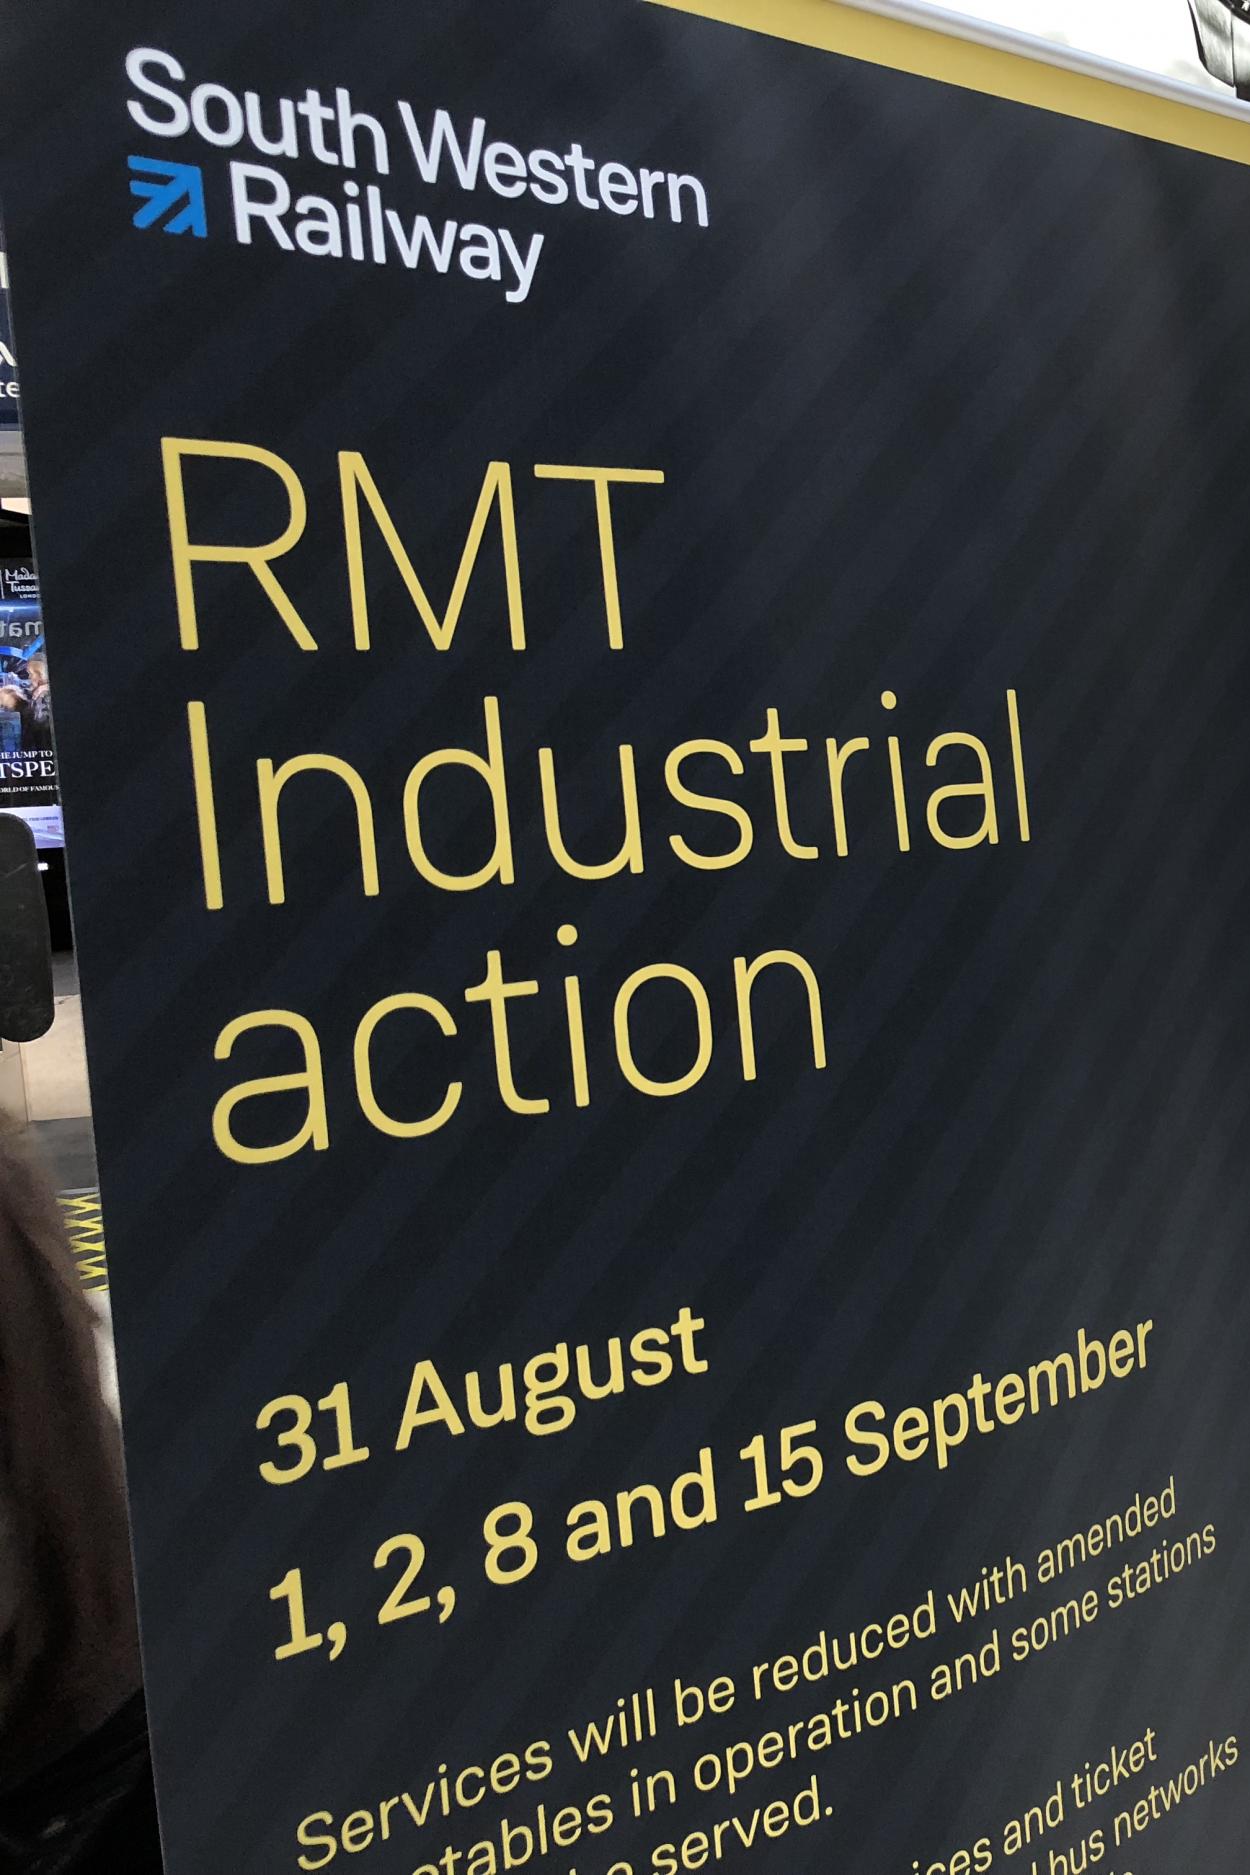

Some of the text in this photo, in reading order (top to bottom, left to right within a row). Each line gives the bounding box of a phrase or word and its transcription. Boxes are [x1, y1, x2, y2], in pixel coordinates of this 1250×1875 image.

[125, 47, 709, 228] South Western
[230, 161, 544, 303] Railway
[161, 437, 665, 650] RMT
[39, 750, 53, 758] TO
[188, 690, 1030, 909] Industrial
[212, 925, 826, 1163] action
[256, 1308, 709, 1484] 31 August
[270, 1320, 1153, 1661] 1, 2, 8 and 15 September
[297, 1476, 1176, 1870] Services will be reduced with amended
[630, 1768, 676, 1817] in
[694, 1677, 917, 1794] operation
[930, 1629, 1000, 1701] and
[1012, 1590, 1098, 1661] some
[1107, 1524, 1216, 1608] stations
[651, 1775, 833, 1875] served.
[1003, 1781, 1064, 1856] and
[1071, 1728, 1157, 1809] ticket
[1114, 1735, 1239, 1847] networks
